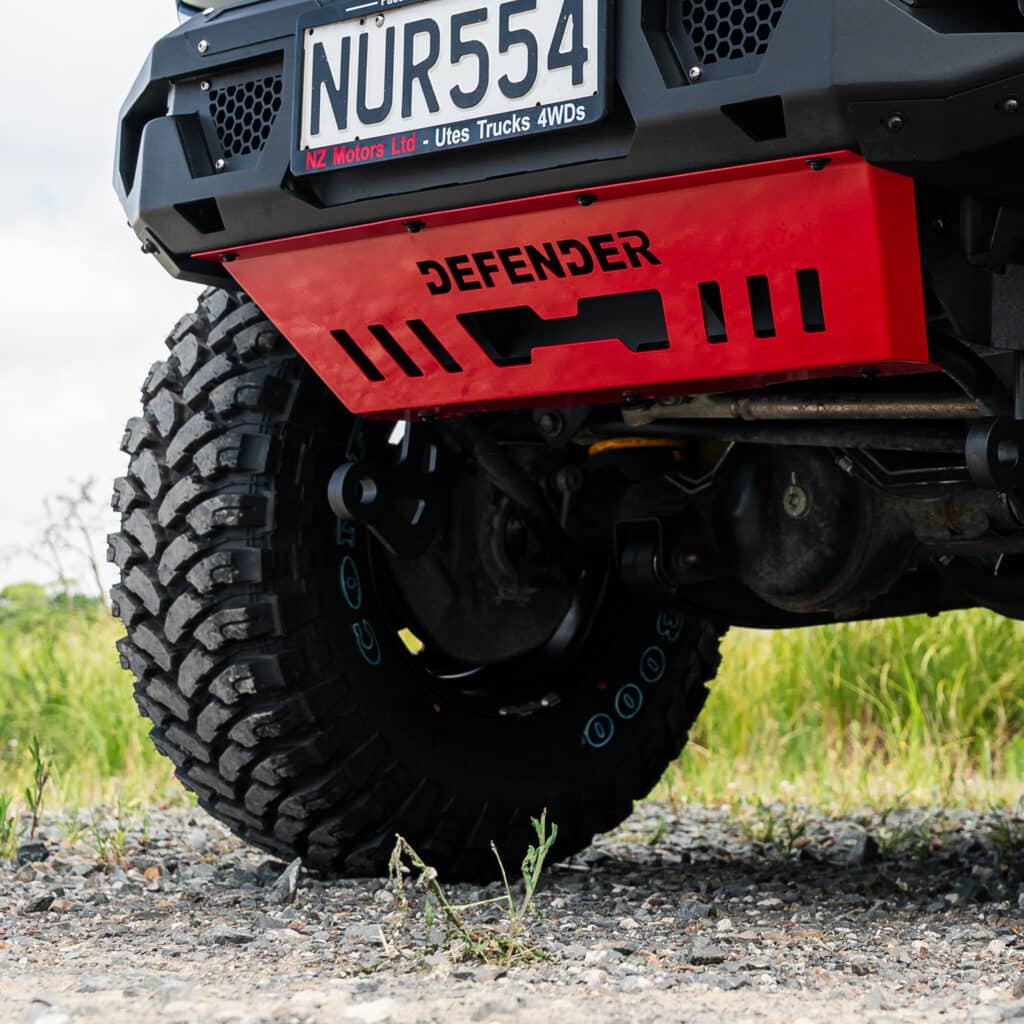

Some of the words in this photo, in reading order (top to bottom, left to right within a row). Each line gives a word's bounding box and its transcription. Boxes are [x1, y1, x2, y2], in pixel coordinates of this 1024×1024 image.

[305, 150, 327, 171] NZ
[332, 142, 385, 166] Motors
[391, 132, 417, 155] Ltd
[435, 126, 470, 147] Utes
[477, 115, 530, 139] Trucks
[537, 103, 586, 130] 4WDs
[416, 230, 662, 295] DEFENDER
